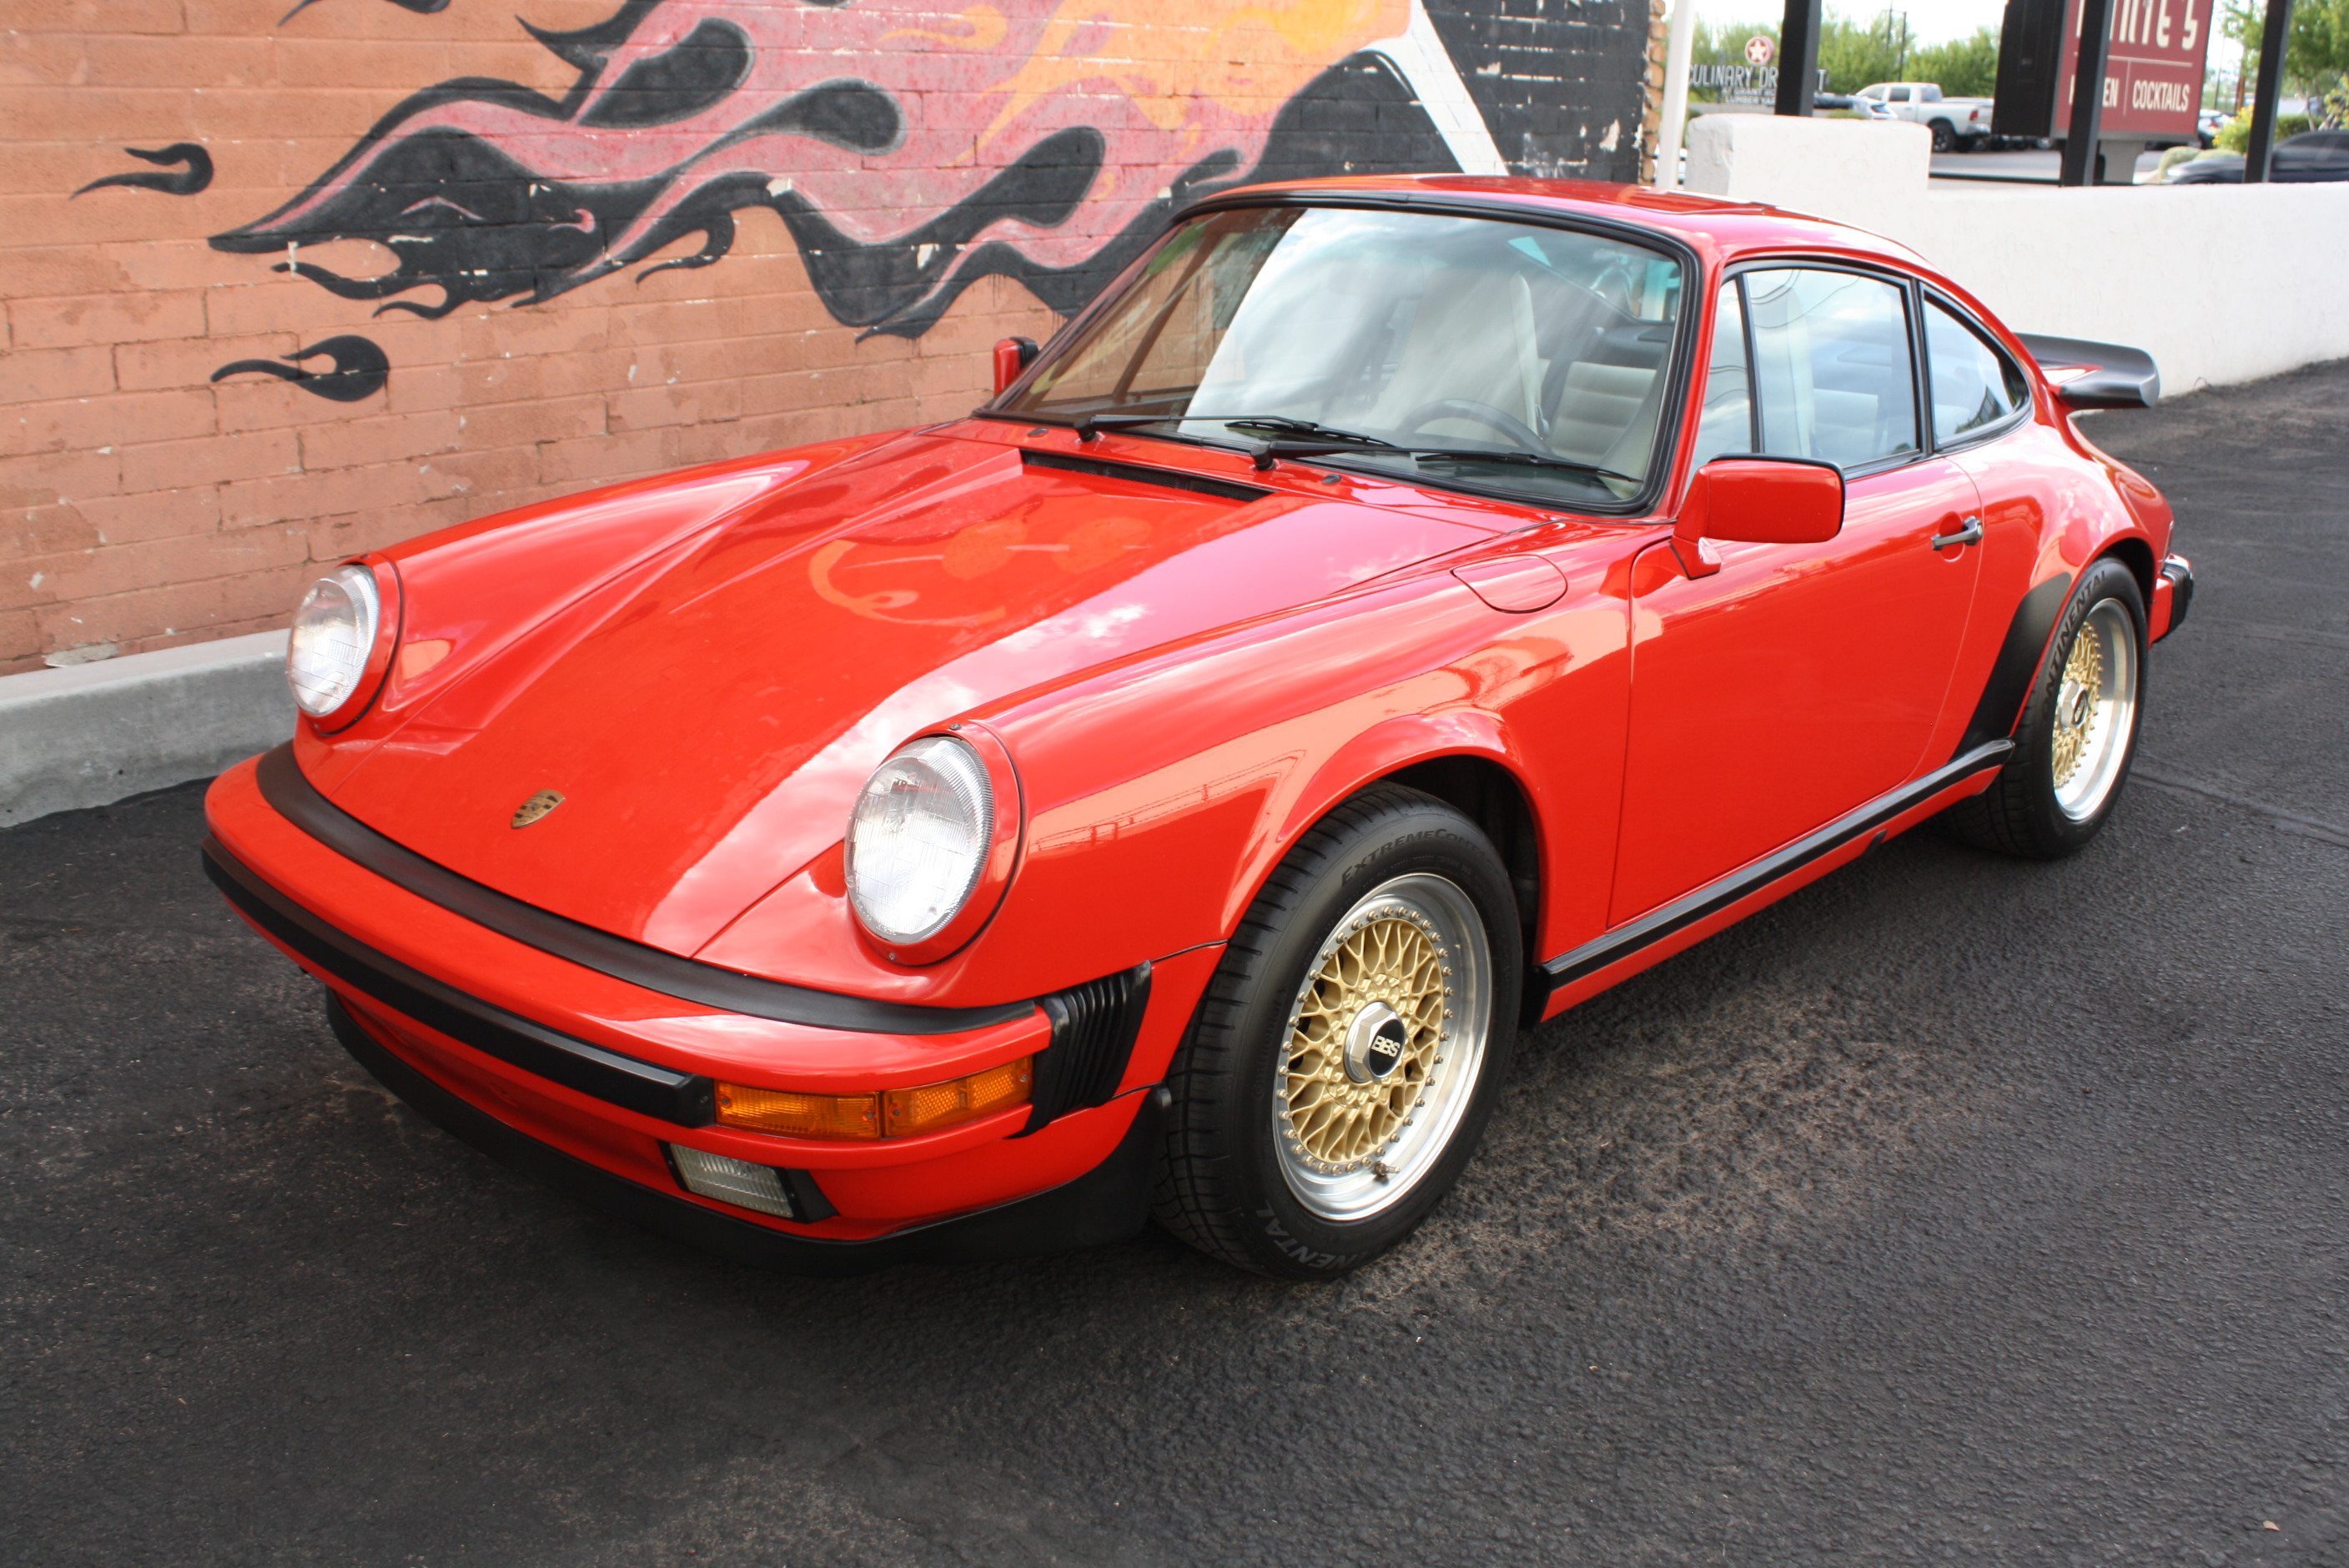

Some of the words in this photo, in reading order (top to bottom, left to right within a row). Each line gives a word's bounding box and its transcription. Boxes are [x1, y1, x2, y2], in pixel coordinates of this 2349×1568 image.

[1688, 64, 1753, 88] CULINARY
[2132, 79, 2191, 112] COCKTAILS
[1371, 1035, 1401, 1058] BBS
